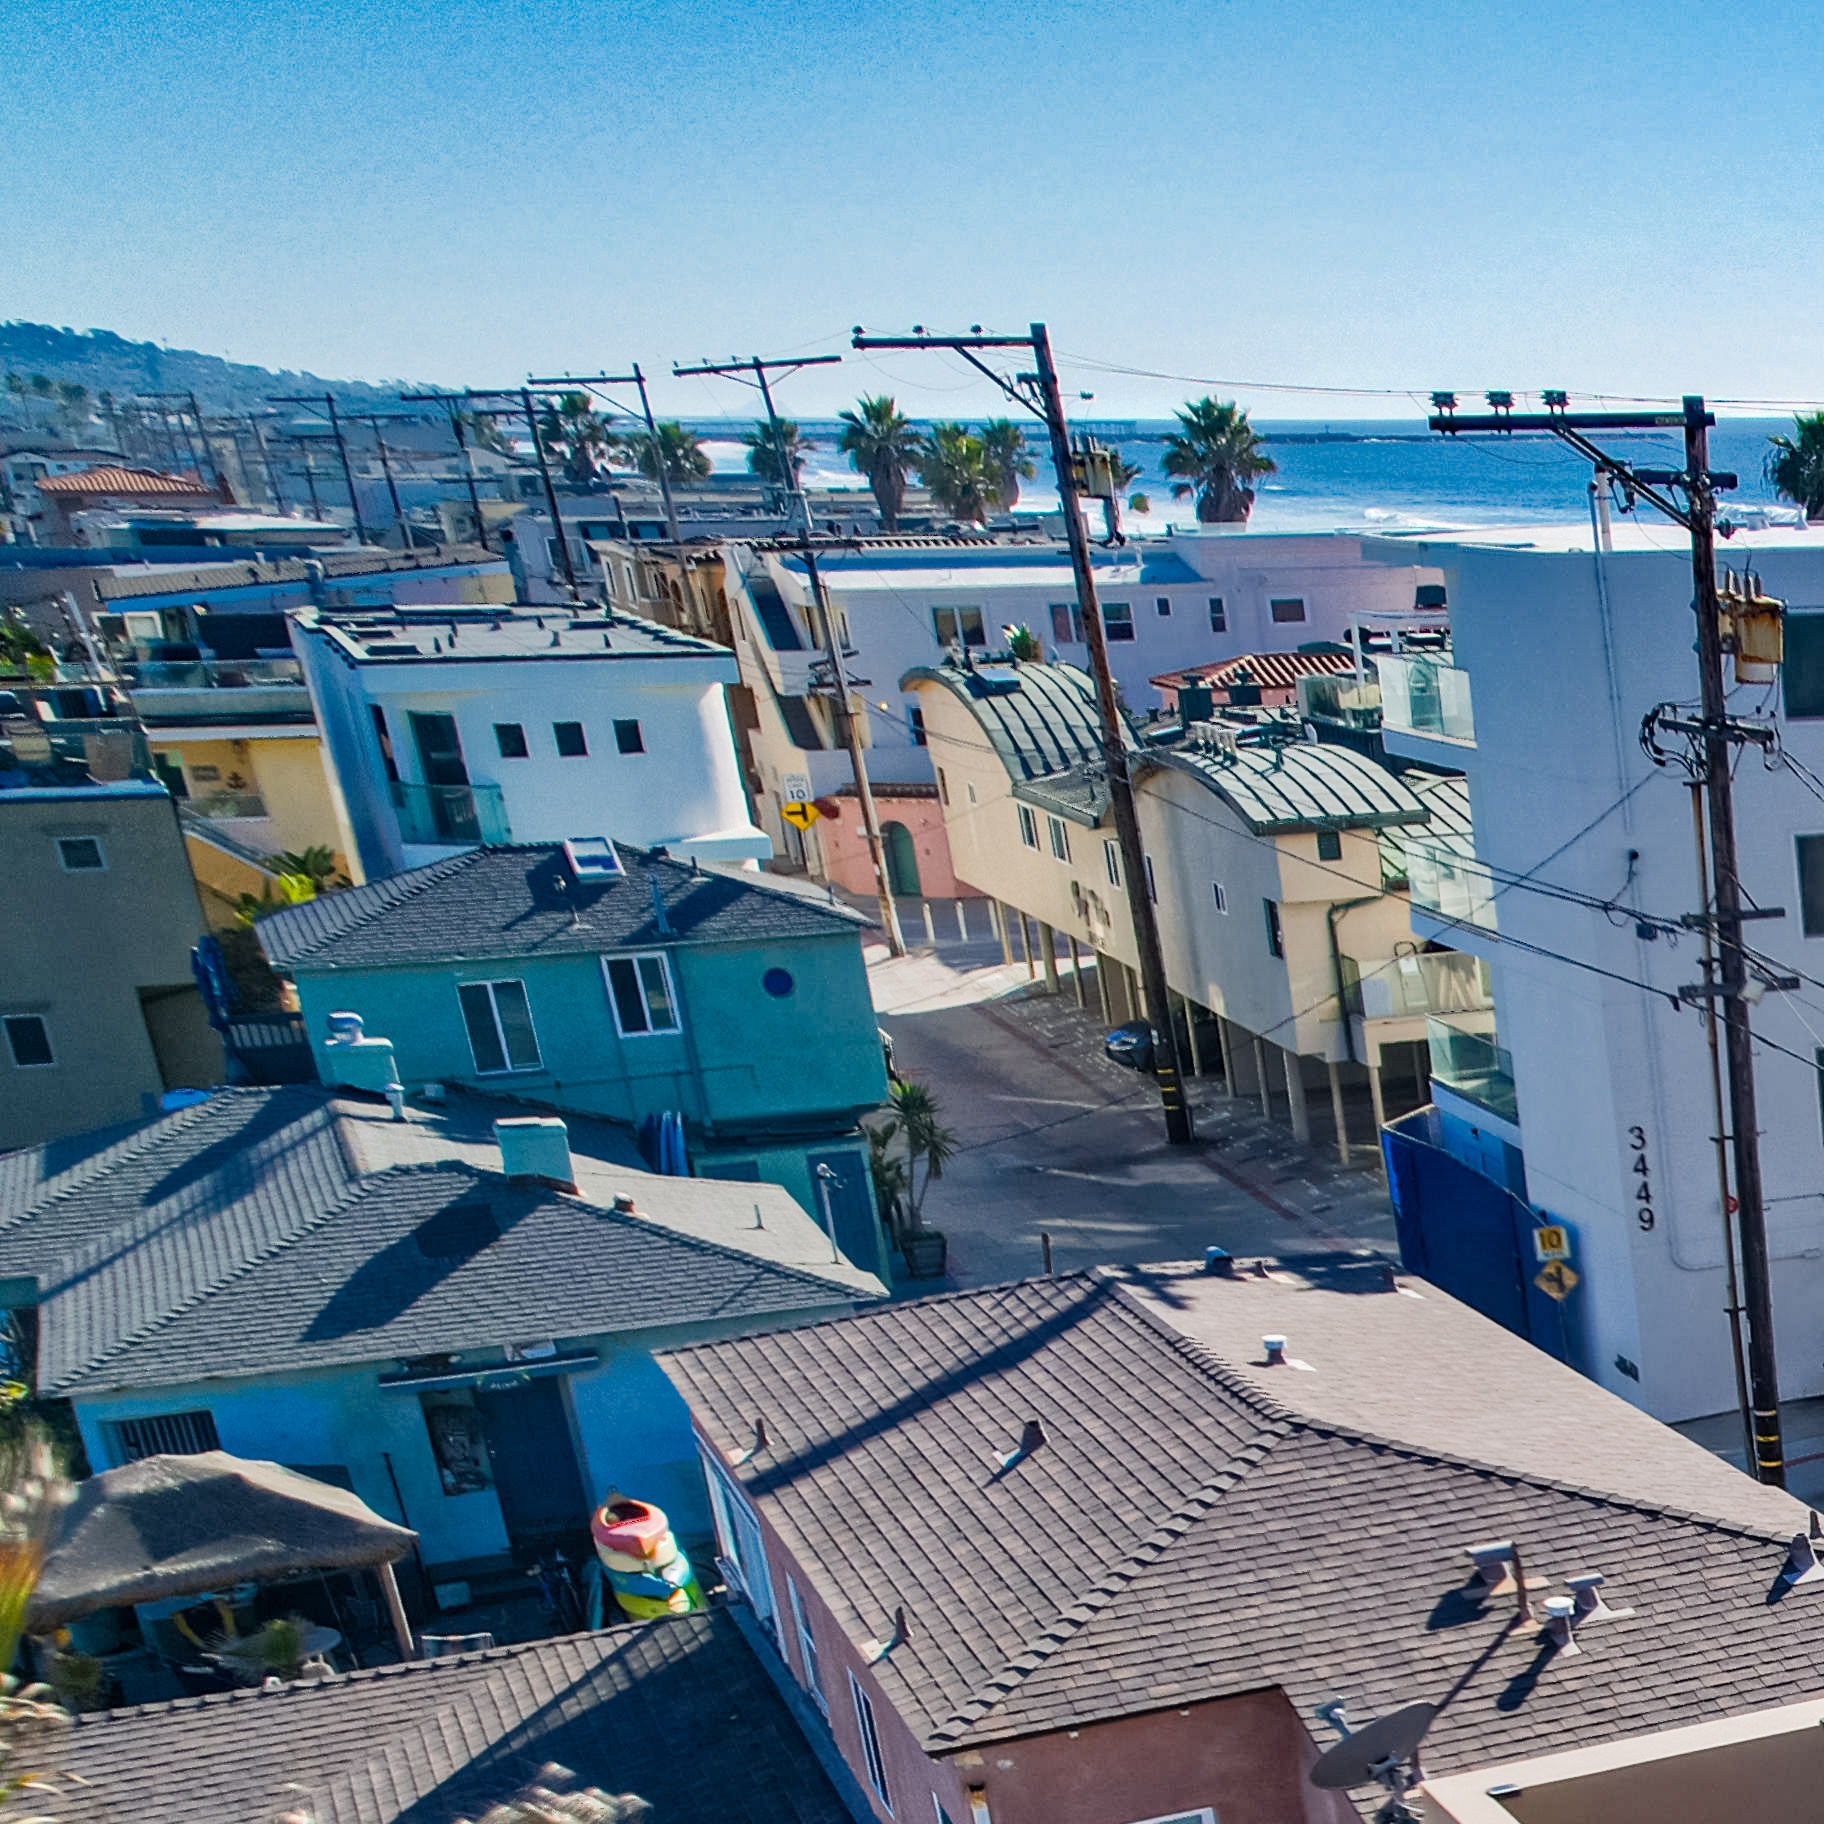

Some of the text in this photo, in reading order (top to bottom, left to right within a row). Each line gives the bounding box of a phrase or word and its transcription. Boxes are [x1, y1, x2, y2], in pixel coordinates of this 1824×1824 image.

[789, 789, 806, 800] 10
[1628, 1125, 1656, 1232] 3449
[1538, 1229, 1563, 1251] 10
